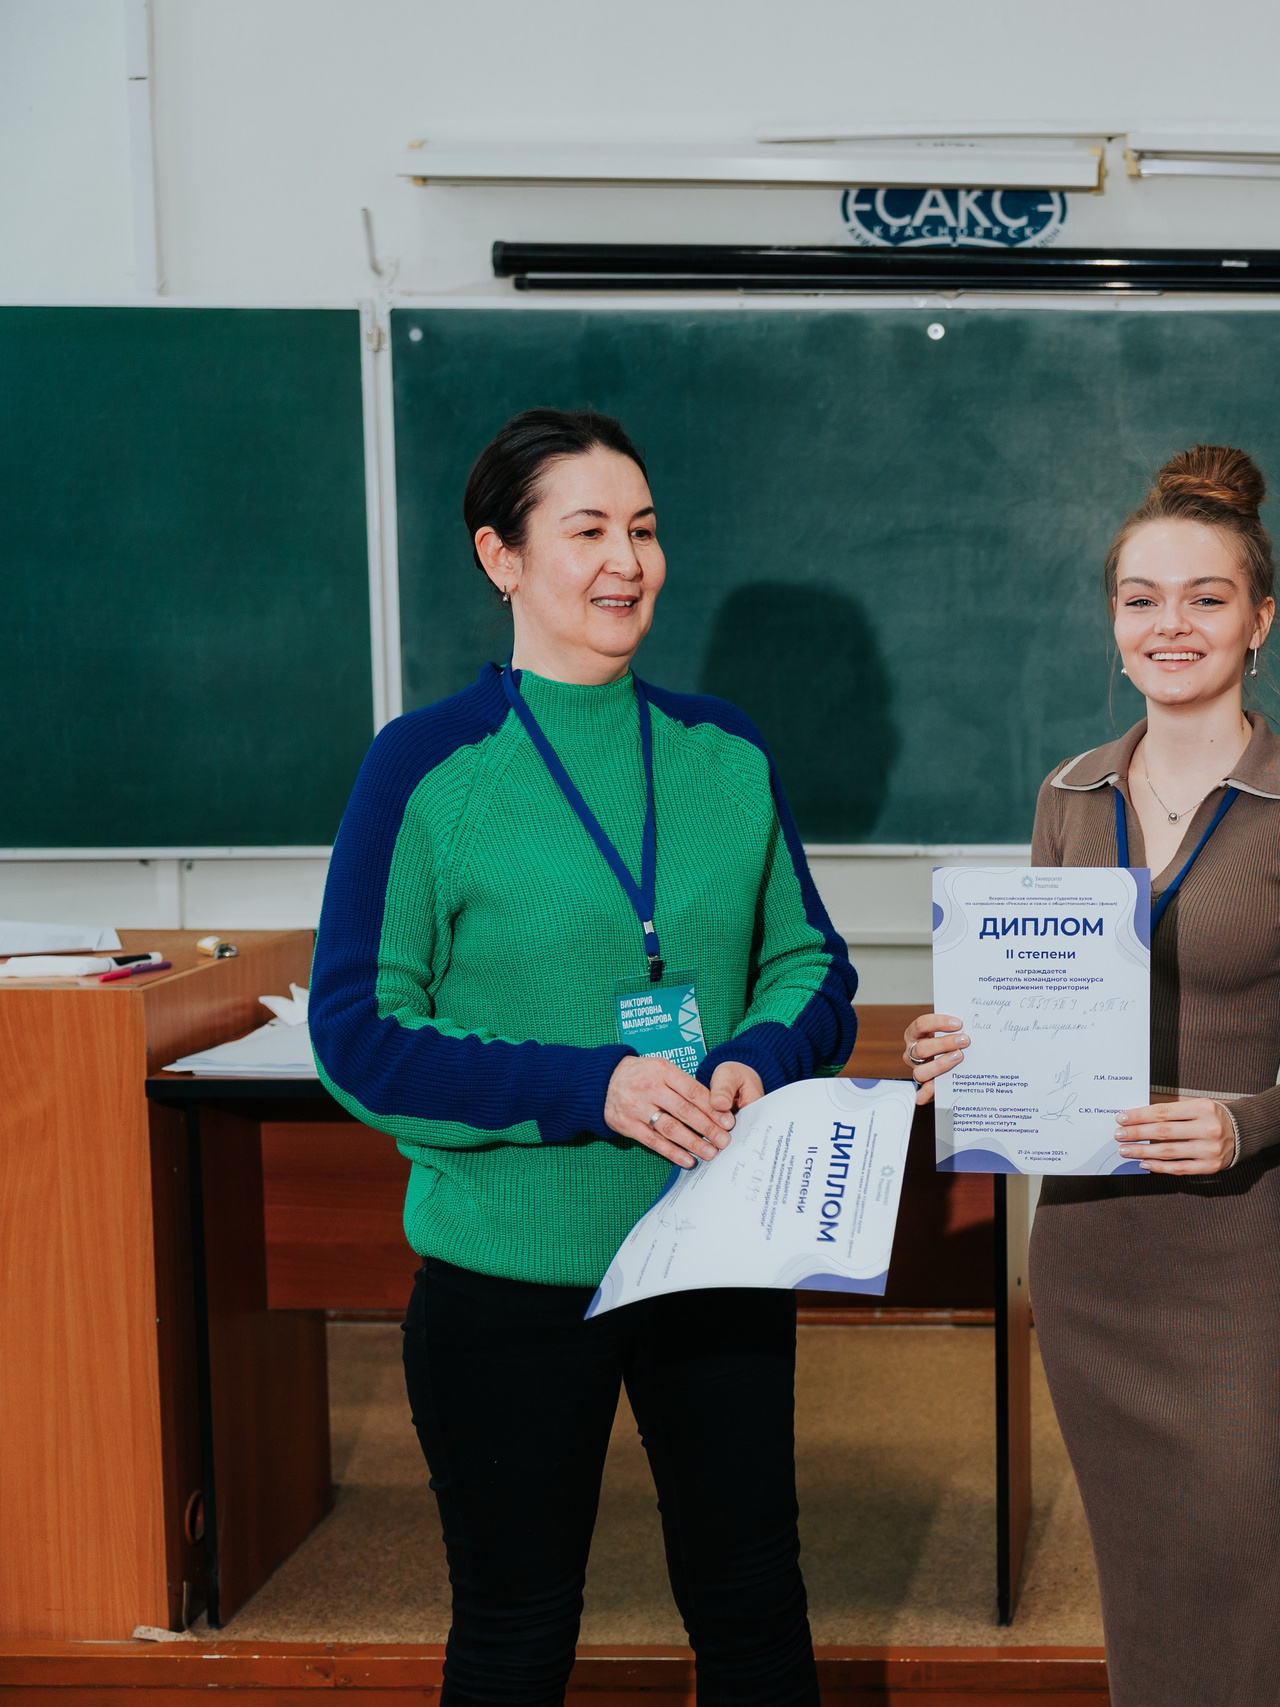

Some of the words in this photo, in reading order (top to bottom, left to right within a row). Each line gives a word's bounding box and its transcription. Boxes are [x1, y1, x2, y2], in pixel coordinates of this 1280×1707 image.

[875, 189, 1029, 228] САКС
[873, 225, 1035, 239] КРАСНОЯРСК
[979, 917, 1104, 940] ДИПЛОМ
[1006, 949, 1014, 959] II
[1018, 951, 1076, 959] степени
[620, 996, 653, 1009] ВИКТОРИЯ
[621, 1004, 663, 1020] ВИКТОРОВНА
[622, 1013, 672, 1029] МАЛАРДЫРОВА
[769, 1135, 783, 1183] продвижения
[781, 1121, 795, 1163] победитель
[773, 1163, 785, 1205] командного
[782, 1155, 795, 1205] награждается
[796, 1157, 814, 1213] степени
[816, 1121, 856, 1242] ДИПЛОМ
[760, 1185, 773, 1227] территории
[766, 1207, 777, 1241] конкурса
